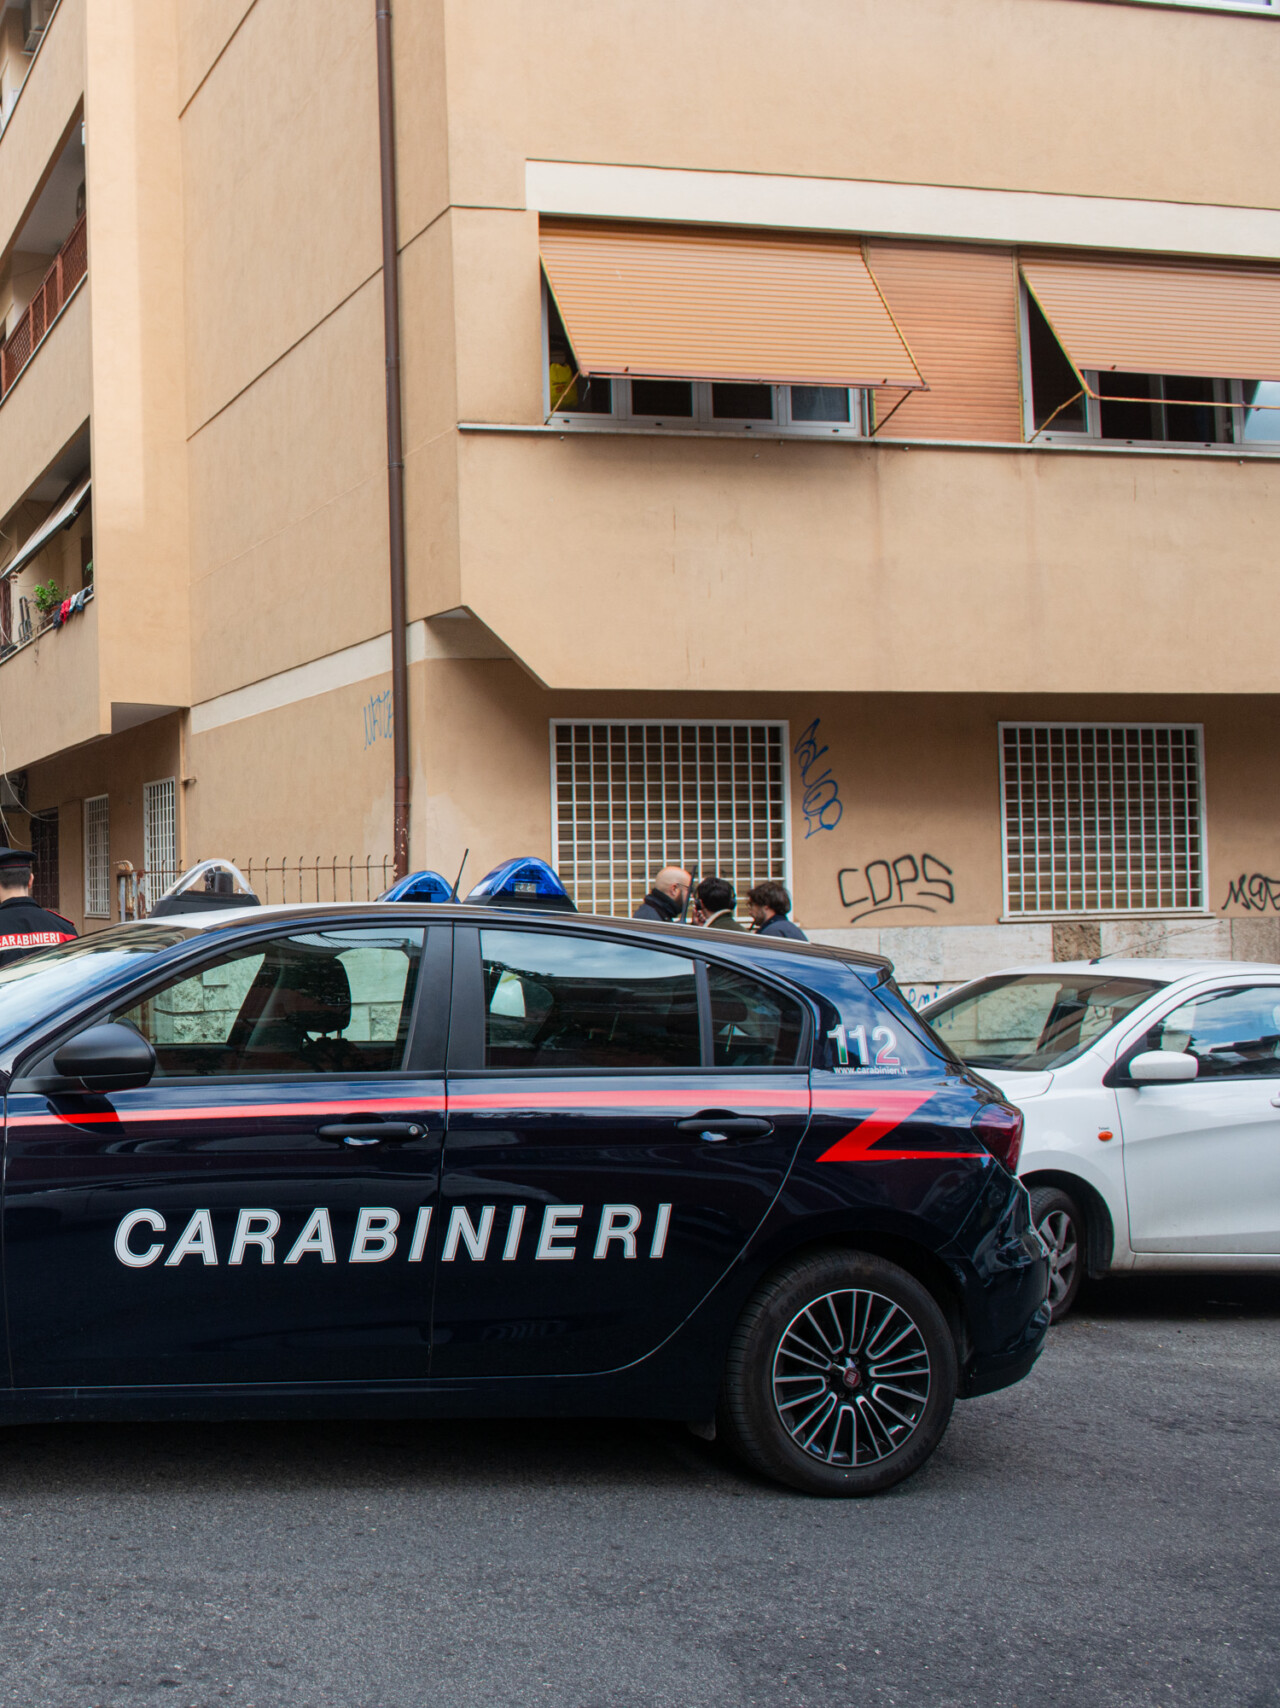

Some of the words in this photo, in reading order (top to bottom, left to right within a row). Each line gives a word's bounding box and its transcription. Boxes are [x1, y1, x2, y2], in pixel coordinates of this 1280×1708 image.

[837, 853, 955, 908] COPS
[827, 1024, 900, 1066] 112
[114, 1203, 673, 1268] CARABINIERI
